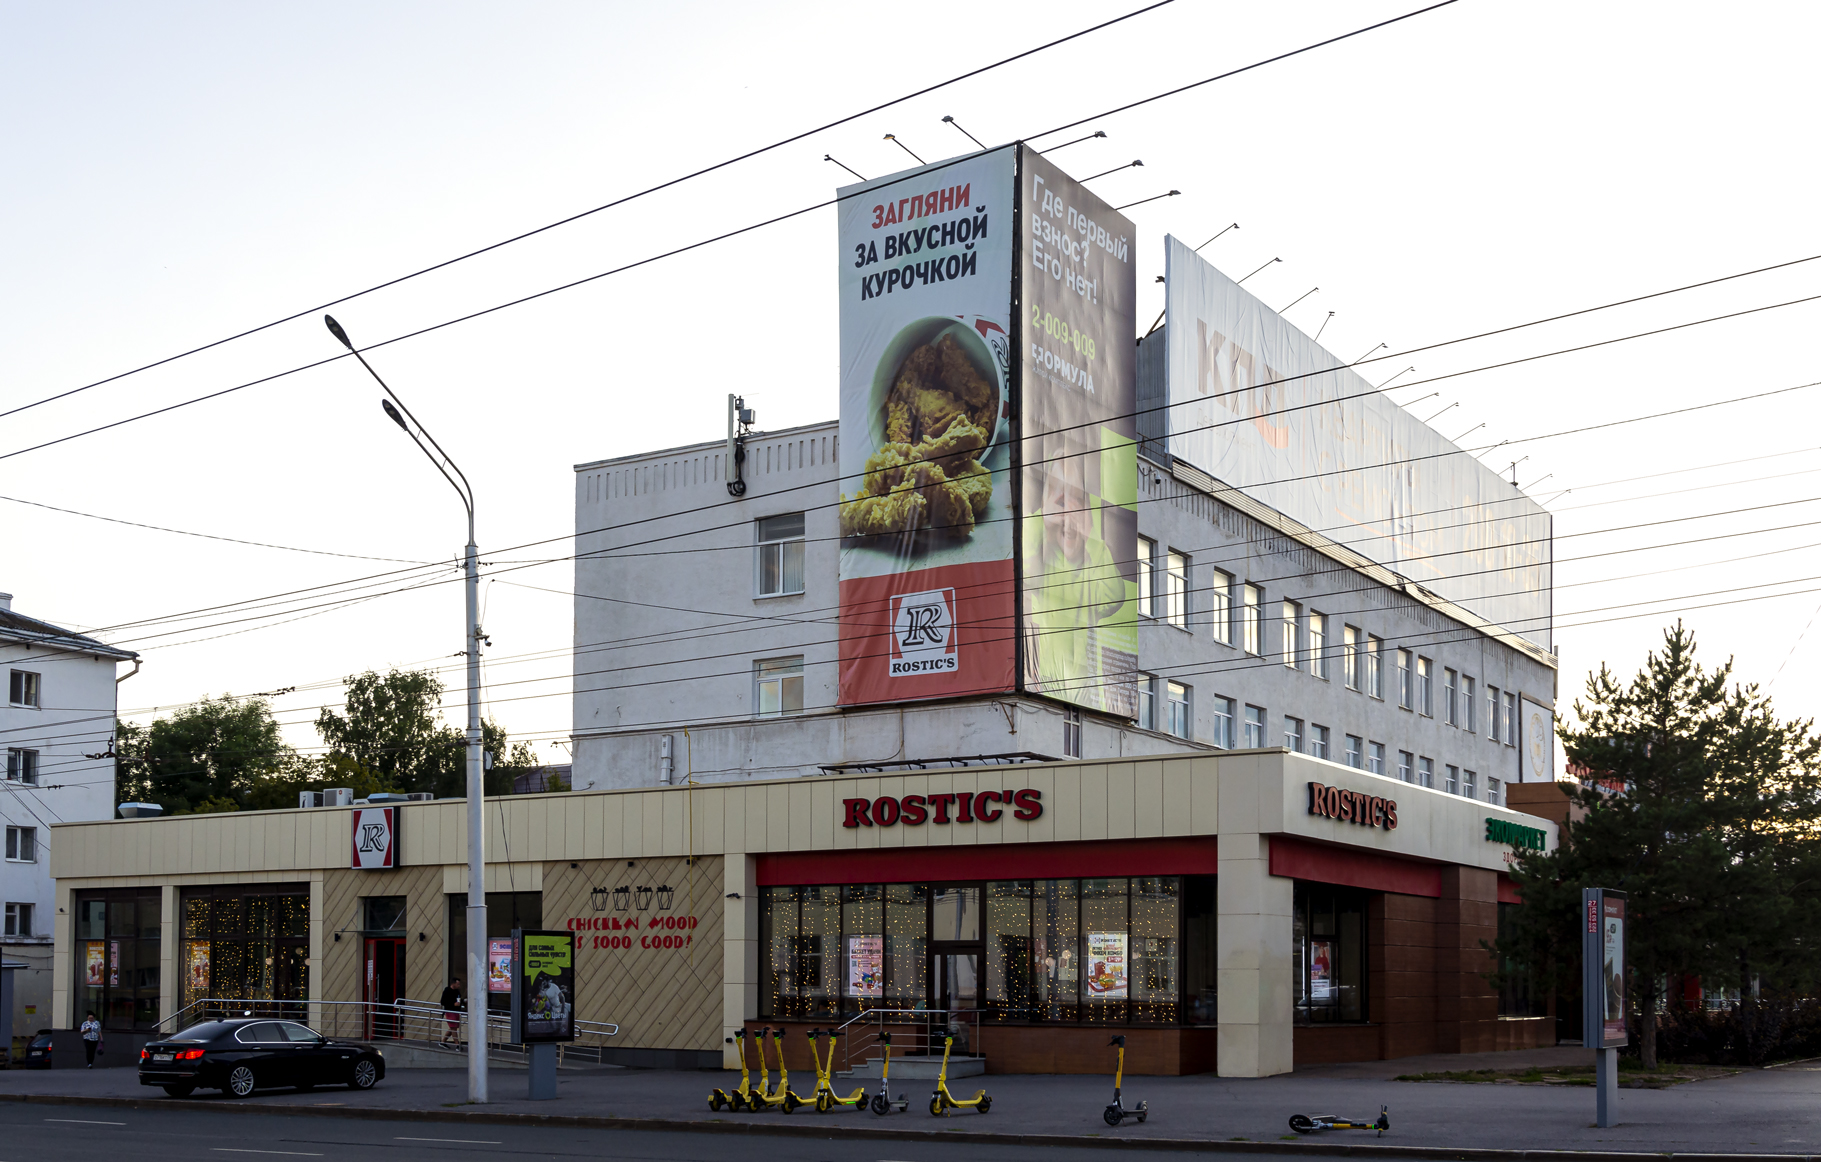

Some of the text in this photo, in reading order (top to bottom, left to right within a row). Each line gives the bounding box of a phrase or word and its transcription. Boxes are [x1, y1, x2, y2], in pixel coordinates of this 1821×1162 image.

[871, 182, 971, 230] ЗАГЛЯНИ
[1032, 173, 1128, 263] Где первый
[854, 205, 988, 269] ЗА ВКУСНОЙ
[1032, 213, 1090, 268] взнос?
[861, 242, 978, 302] КУРОЧКОЙ
[1032, 238, 1098, 305] Его нет!
[1031, 304, 1096, 361] 2-009-009
[892, 657, 956, 674] ROSTIC'S
[843, 788, 1044, 828] ROSTIC'S
[1308, 781, 1398, 831] ROSTIC'S
[359, 823, 386, 852] R
[1485, 817, 1547, 851] ЭКОМАРКЕТ
[567, 915, 698, 931] CHICKEN MOOD
[593, 935, 632, 949] SOOO
